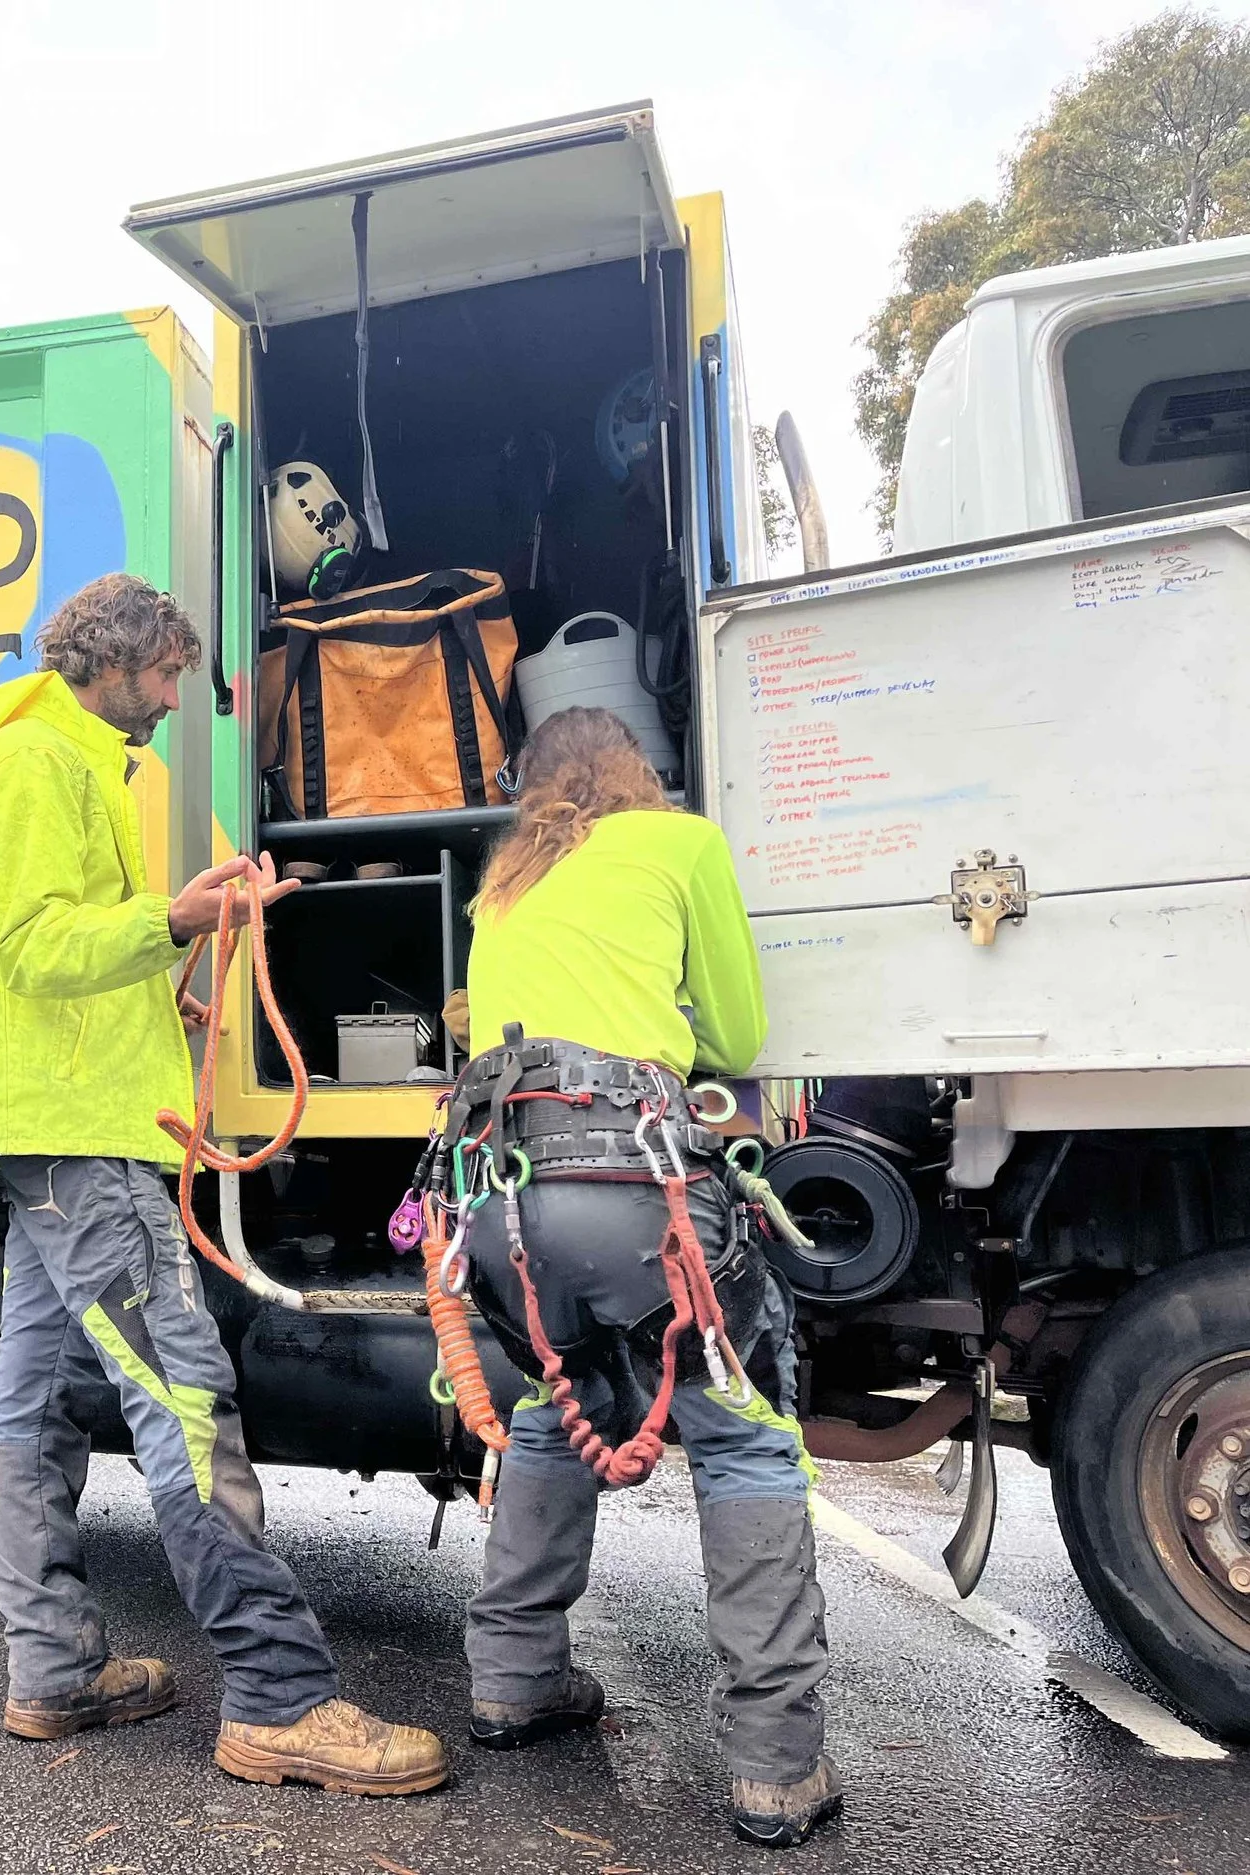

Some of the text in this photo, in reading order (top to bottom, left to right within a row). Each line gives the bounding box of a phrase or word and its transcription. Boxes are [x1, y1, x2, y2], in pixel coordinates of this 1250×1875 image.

[899, 563, 949, 580] GLENDALE
[953, 558, 976, 571] EAST
[1073, 580, 1097, 590] LUKE
[747, 625, 823, 647] SITE SPECIFIC
[887, 679, 936, 694] DRIVEWAY
[798, 735, 839, 748] CHIPPER
[822, 745, 842, 756] USE
